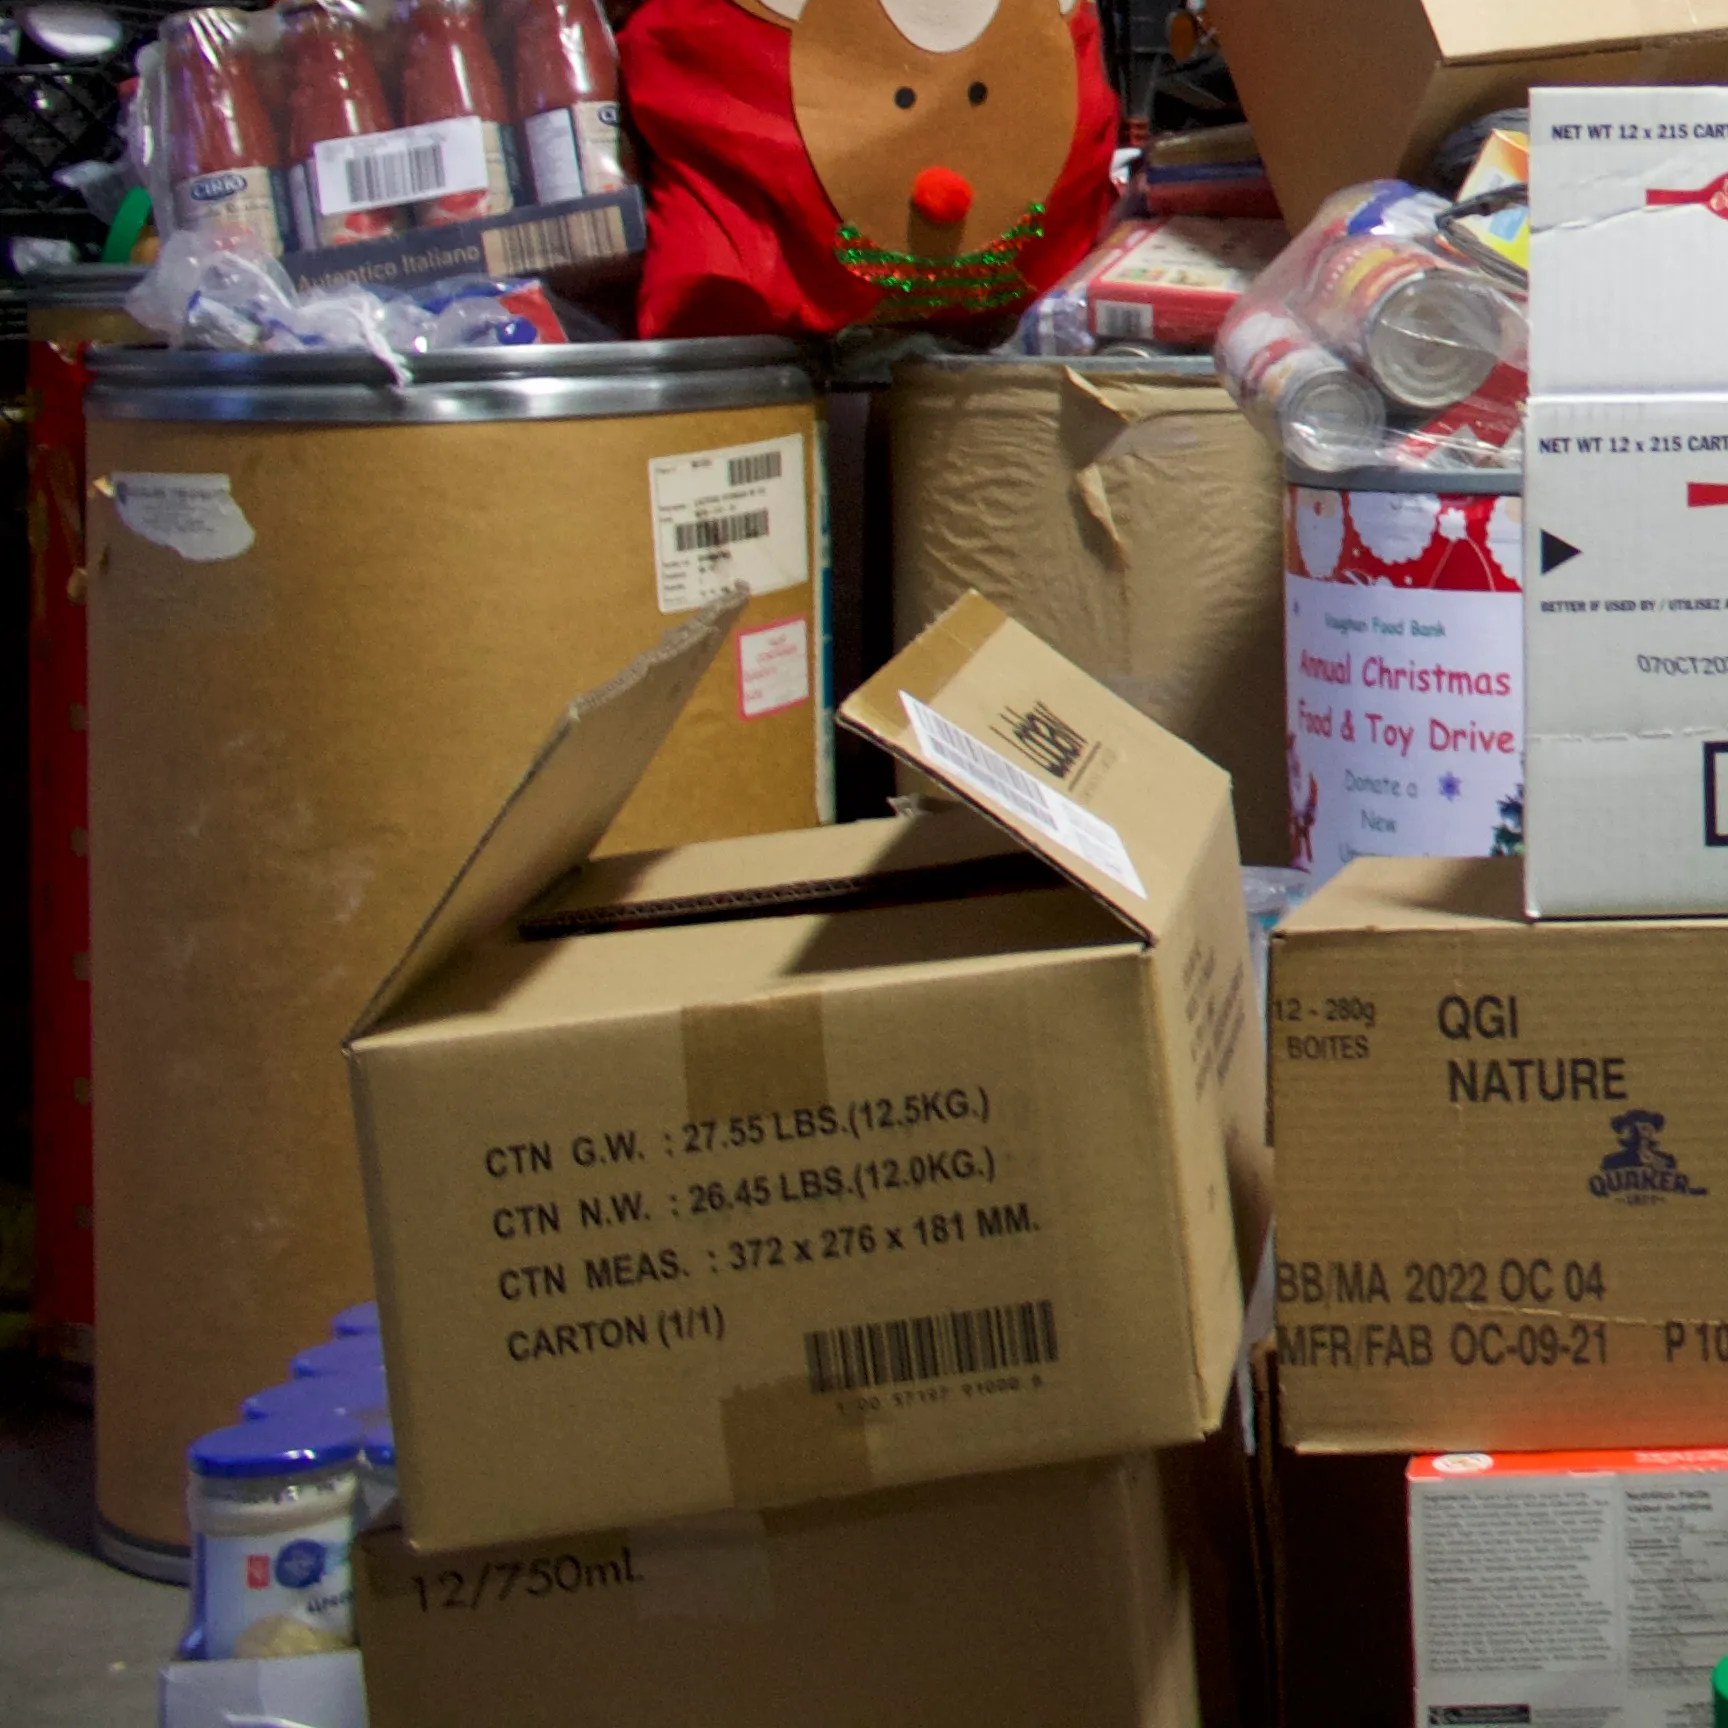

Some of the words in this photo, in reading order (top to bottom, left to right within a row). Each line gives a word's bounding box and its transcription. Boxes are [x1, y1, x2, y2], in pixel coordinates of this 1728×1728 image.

[1551, 125, 1582, 139] NET
[1587, 125, 1612, 139] WT
[1619, 125, 1637, 139] 12
[1643, 128, 1652, 139] x
[1657, 125, 1688, 139] 215
[1362, 654, 1511, 695] Christmas
[1341, 710, 1355, 743] &
[1365, 713, 1414, 757] Toy
[1429, 718, 1515, 753] Drive
[1274, 998, 1301, 1021] 12
[1326, 998, 1375, 1028] 280g
[1439, 996, 1518, 1039] QGI
[1449, 1058, 1627, 1102] NATURE
[485, 1142, 553, 1177] CTN
[573, 1132, 645, 1167] G.W.
[683, 1120, 765, 1154] 27.55
[1589, 1171, 1690, 1197] QUAKER
[493, 1203, 560, 1239] CTN
[580, 1192, 650, 1228] N.W.
[689, 1174, 771, 1215] 26.45
[500, 1263, 567, 1301] CTN
[586, 1250, 689, 1290] MEAS.
[729, 1236, 783, 1270] 372
[794, 1242, 811, 1263] x
[823, 1226, 876, 1260] 276
[886, 1228, 905, 1250] x
[913, 1213, 966, 1246] 181
[978, 1203, 1040, 1239] MM.
[1405, 1264, 1486, 1303] 2022
[1501, 1261, 1552, 1303] OC
[1564, 1262, 1605, 1301] 04
[508, 1315, 647, 1361] CARTON
[658, 1305, 725, 1350] (1/1)
[1276, 1324, 1432, 1366] MFR/FAB
[1449, 1323, 1608, 1365] OC-09-21
